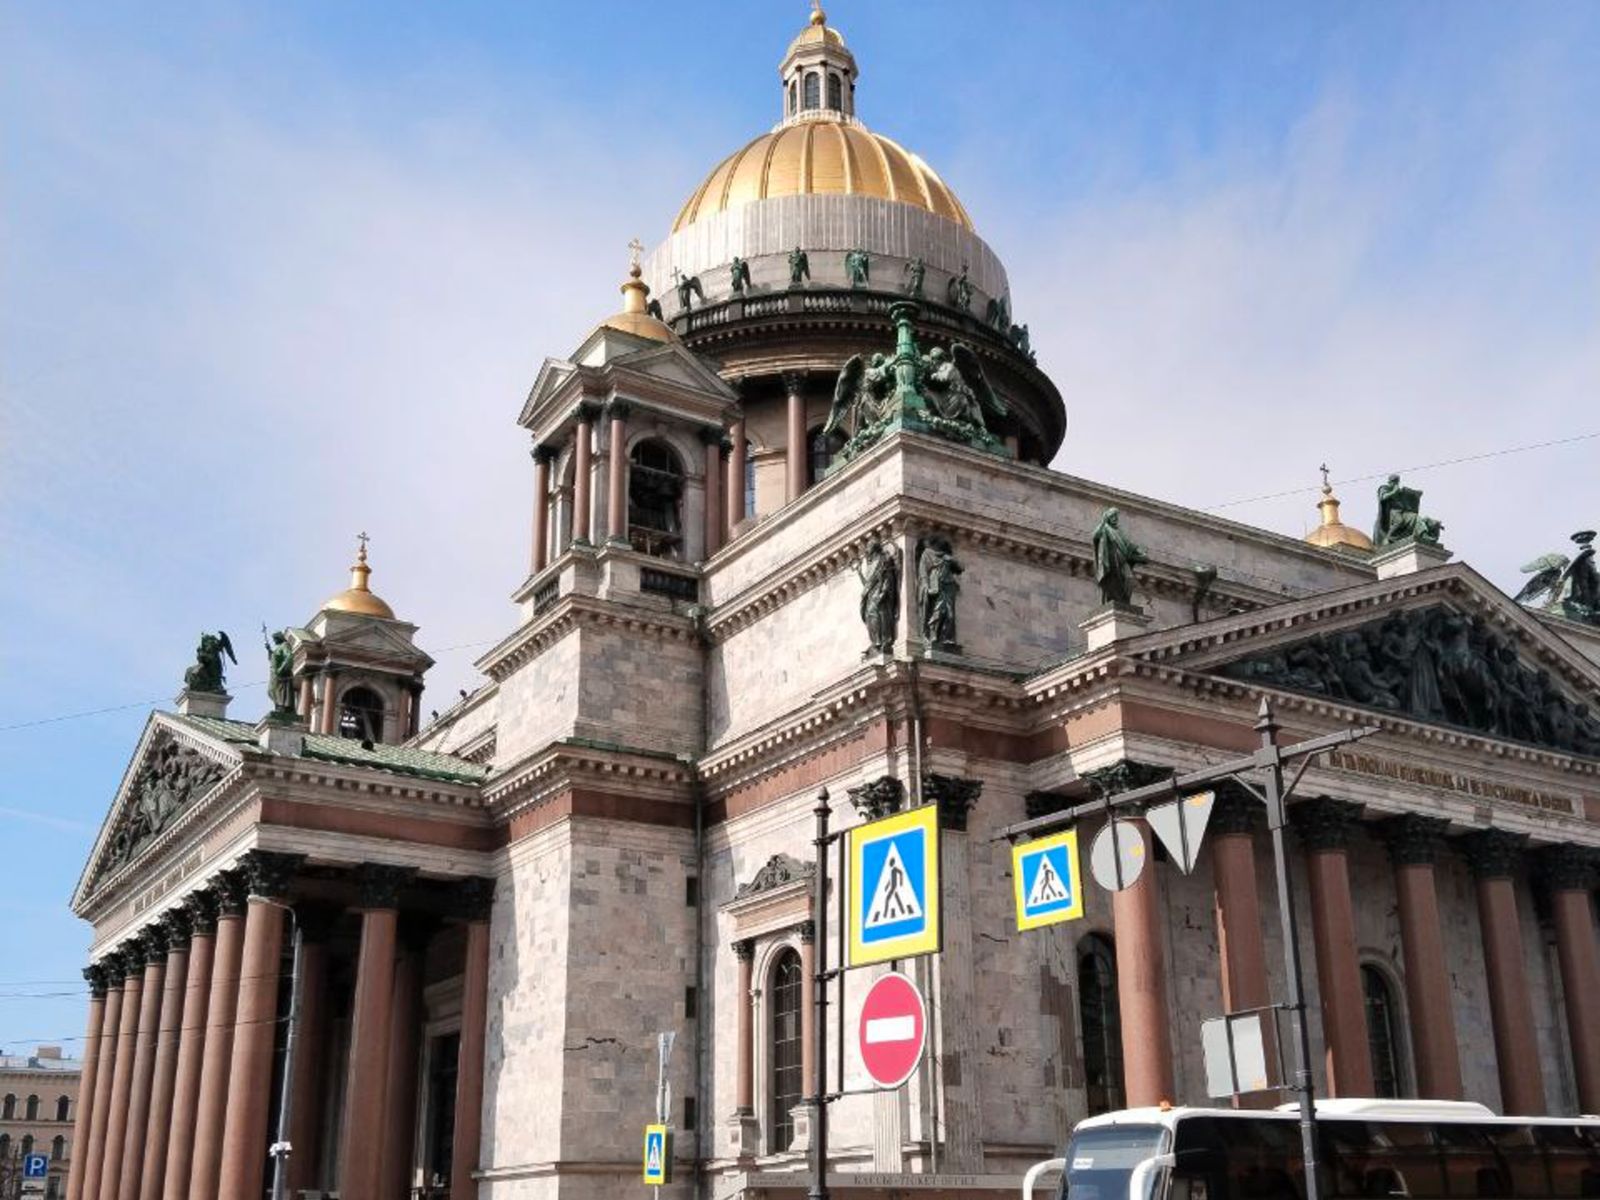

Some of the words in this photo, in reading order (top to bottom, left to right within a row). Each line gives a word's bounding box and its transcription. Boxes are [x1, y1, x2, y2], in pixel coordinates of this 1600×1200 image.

[30, 1158, 44, 1175] P
[900, 1175, 936, 1186] TICKET
[941, 1175, 977, 1186] OFFICE
